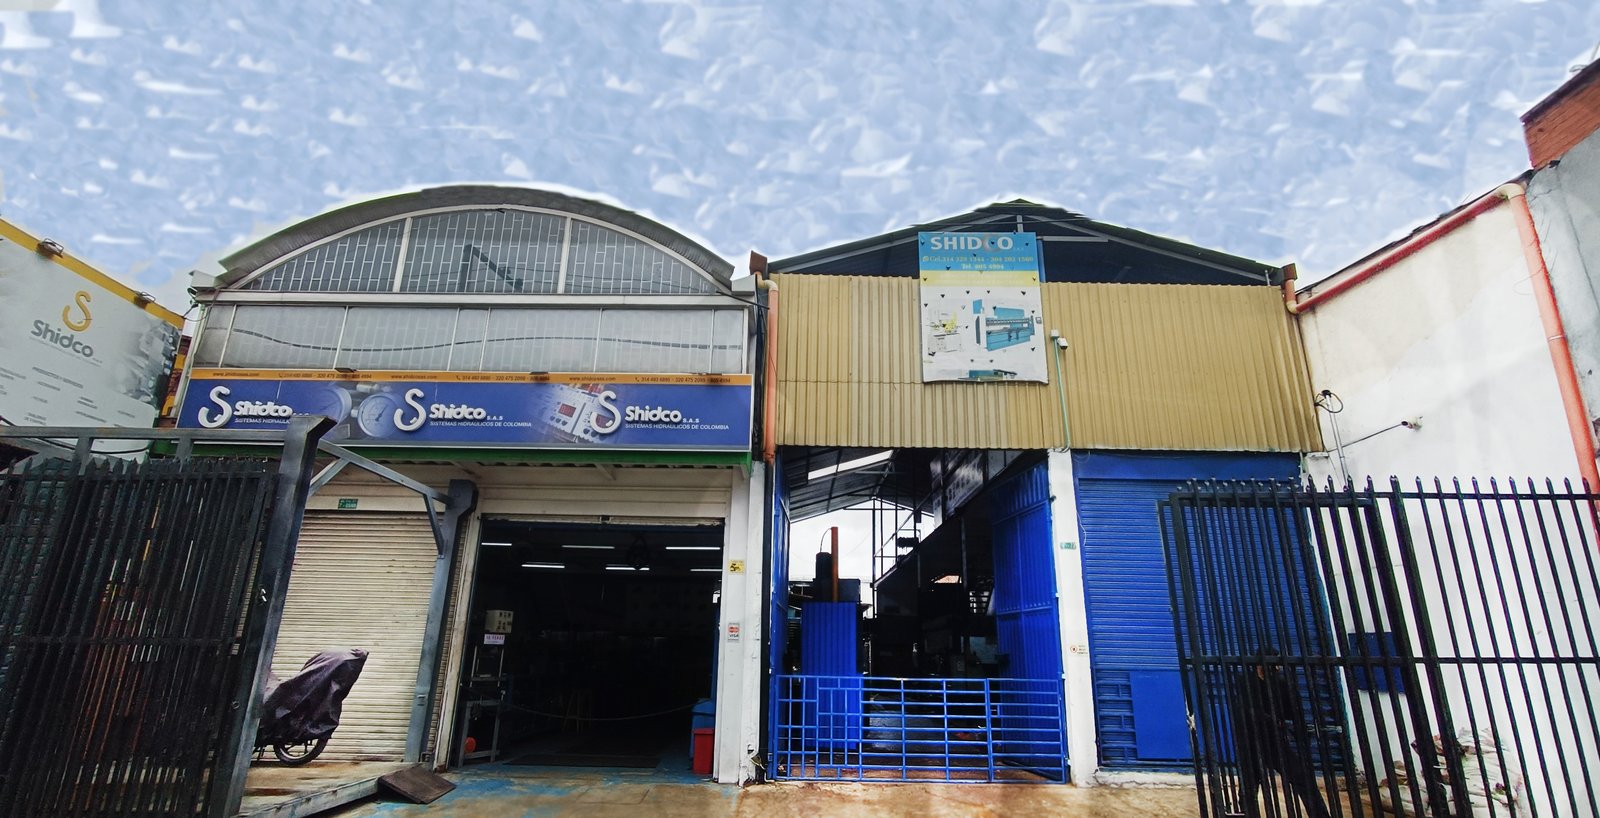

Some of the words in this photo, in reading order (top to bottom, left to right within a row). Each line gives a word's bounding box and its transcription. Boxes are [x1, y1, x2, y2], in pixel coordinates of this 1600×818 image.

[931, 236, 1013, 250] SHIDCO
[31, 319, 93, 358] Shidco
[233, 401, 293, 418] Shidco
[429, 403, 487, 420] Shidco
[624, 405, 682, 423] Shidco
